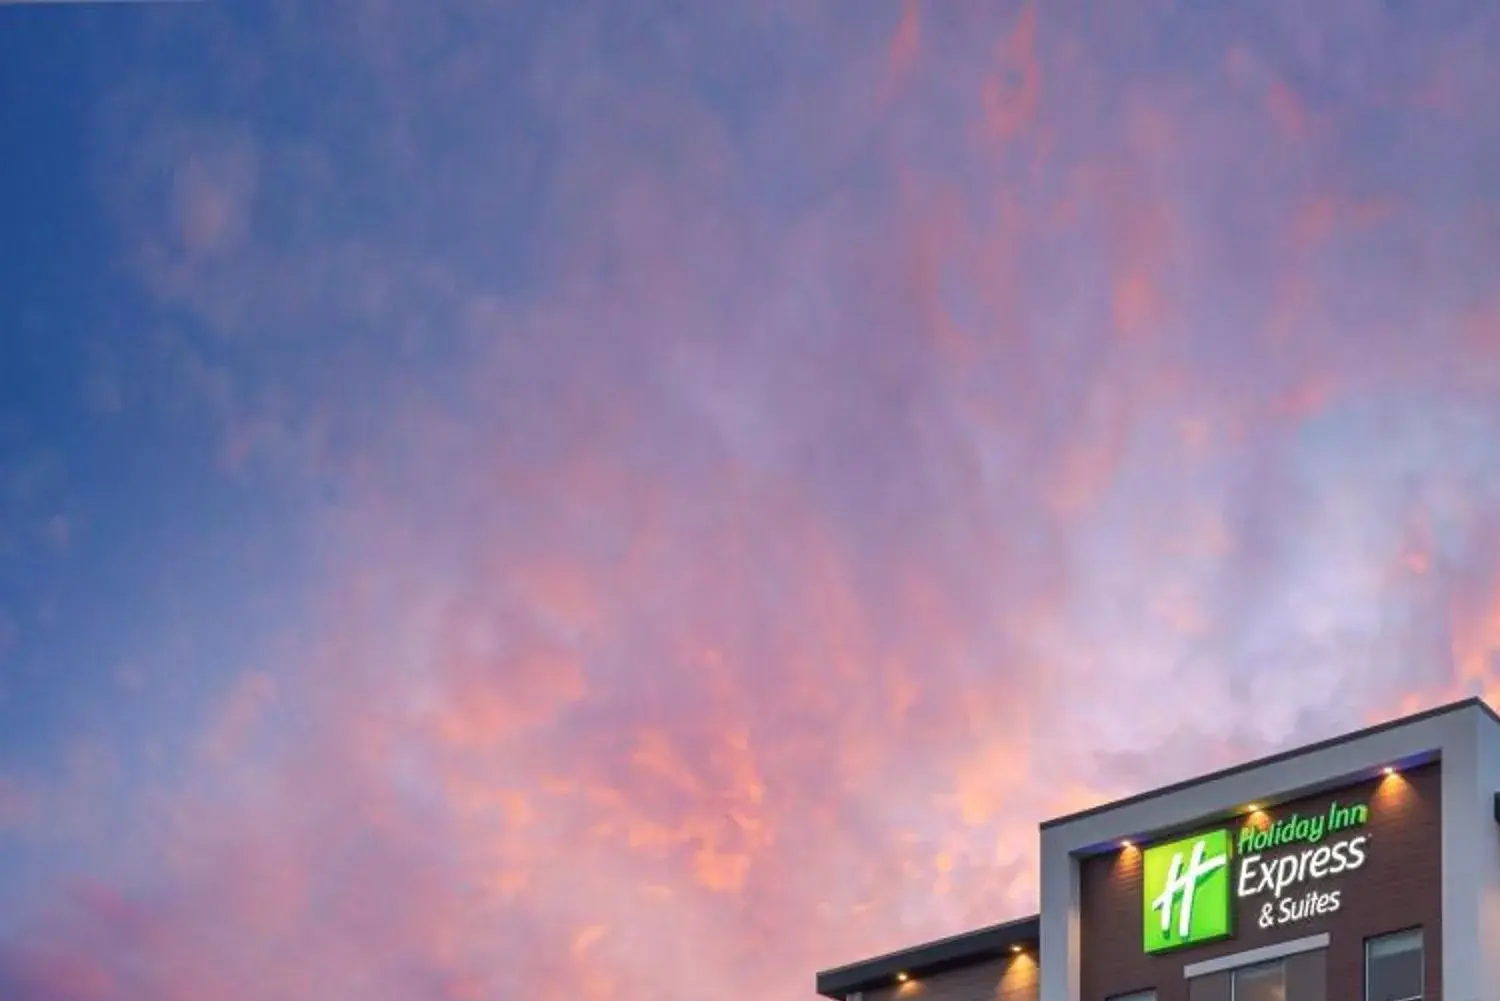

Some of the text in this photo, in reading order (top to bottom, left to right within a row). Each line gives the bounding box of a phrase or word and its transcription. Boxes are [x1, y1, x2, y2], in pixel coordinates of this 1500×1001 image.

[1237, 801, 1369, 854] Holiday Inn
[1237, 835, 1368, 897] Express
[1258, 889, 1342, 929] & Suites
